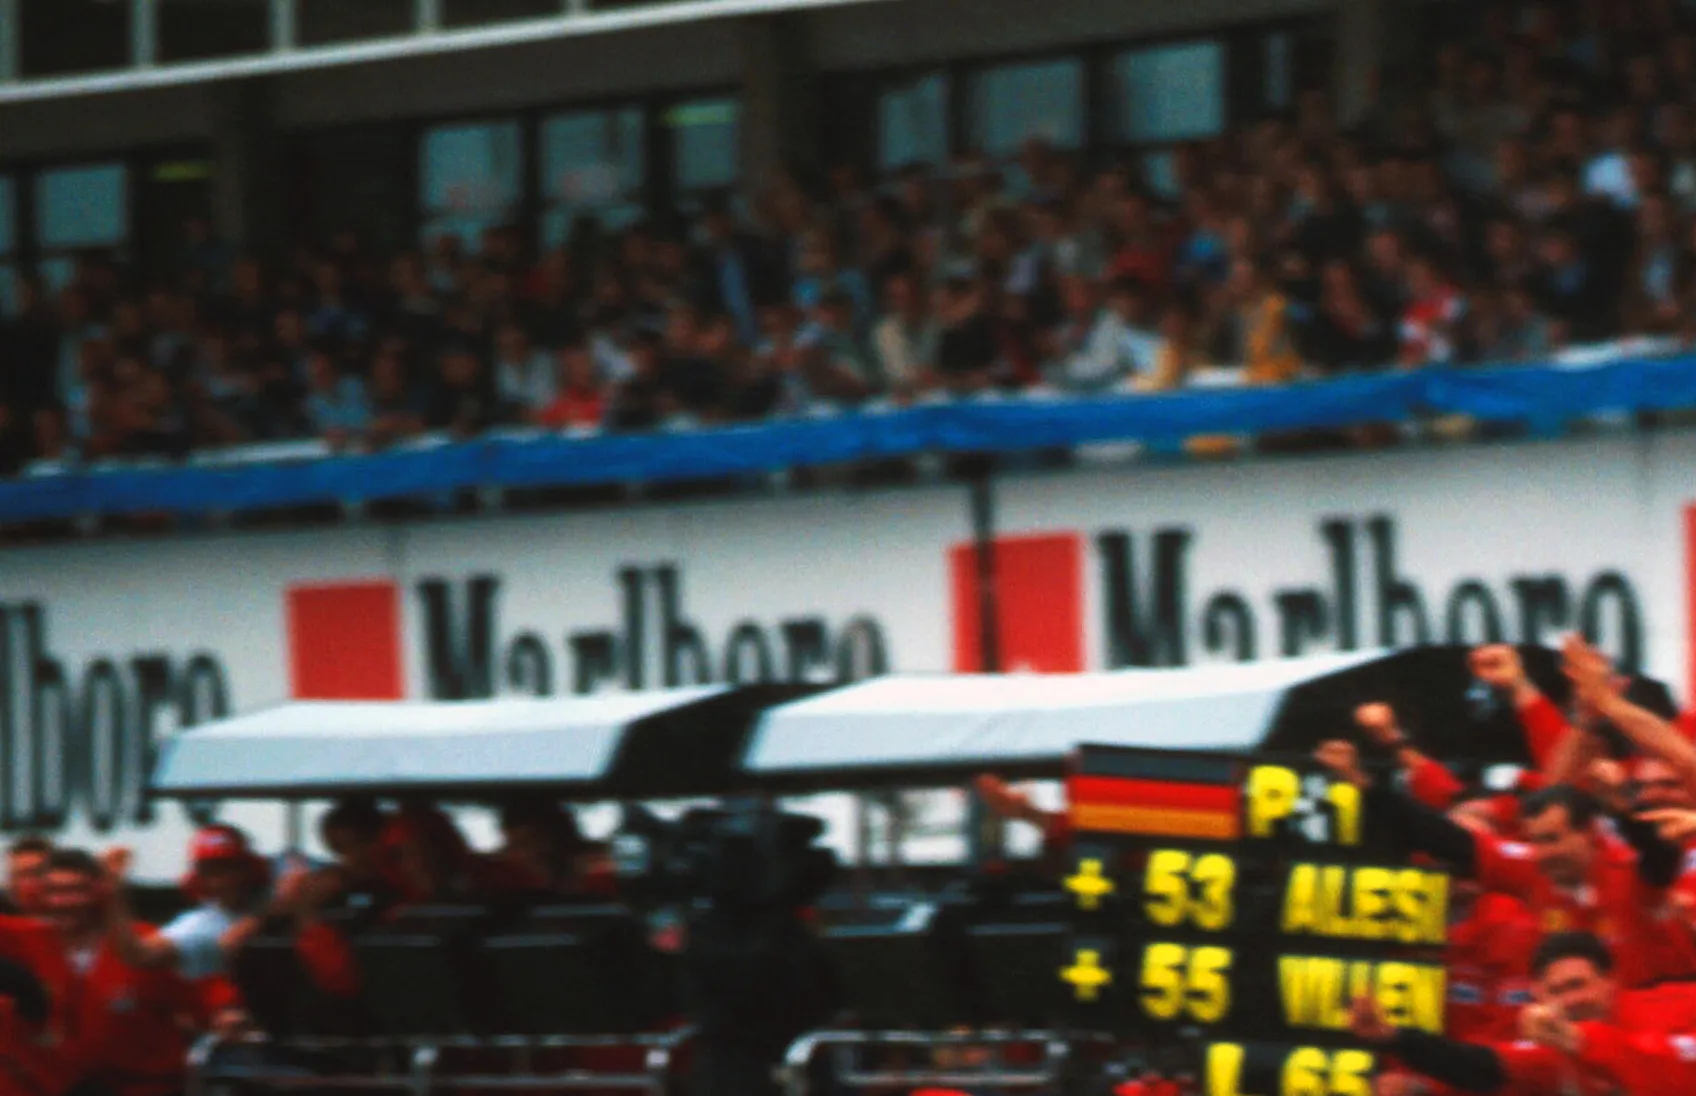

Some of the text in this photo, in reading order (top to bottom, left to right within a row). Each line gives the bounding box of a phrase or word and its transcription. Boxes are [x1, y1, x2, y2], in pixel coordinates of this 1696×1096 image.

[1144, 849, 1235, 929] 53
[1279, 862, 1448, 943] ALESI
[1141, 942, 1231, 1022] 55
